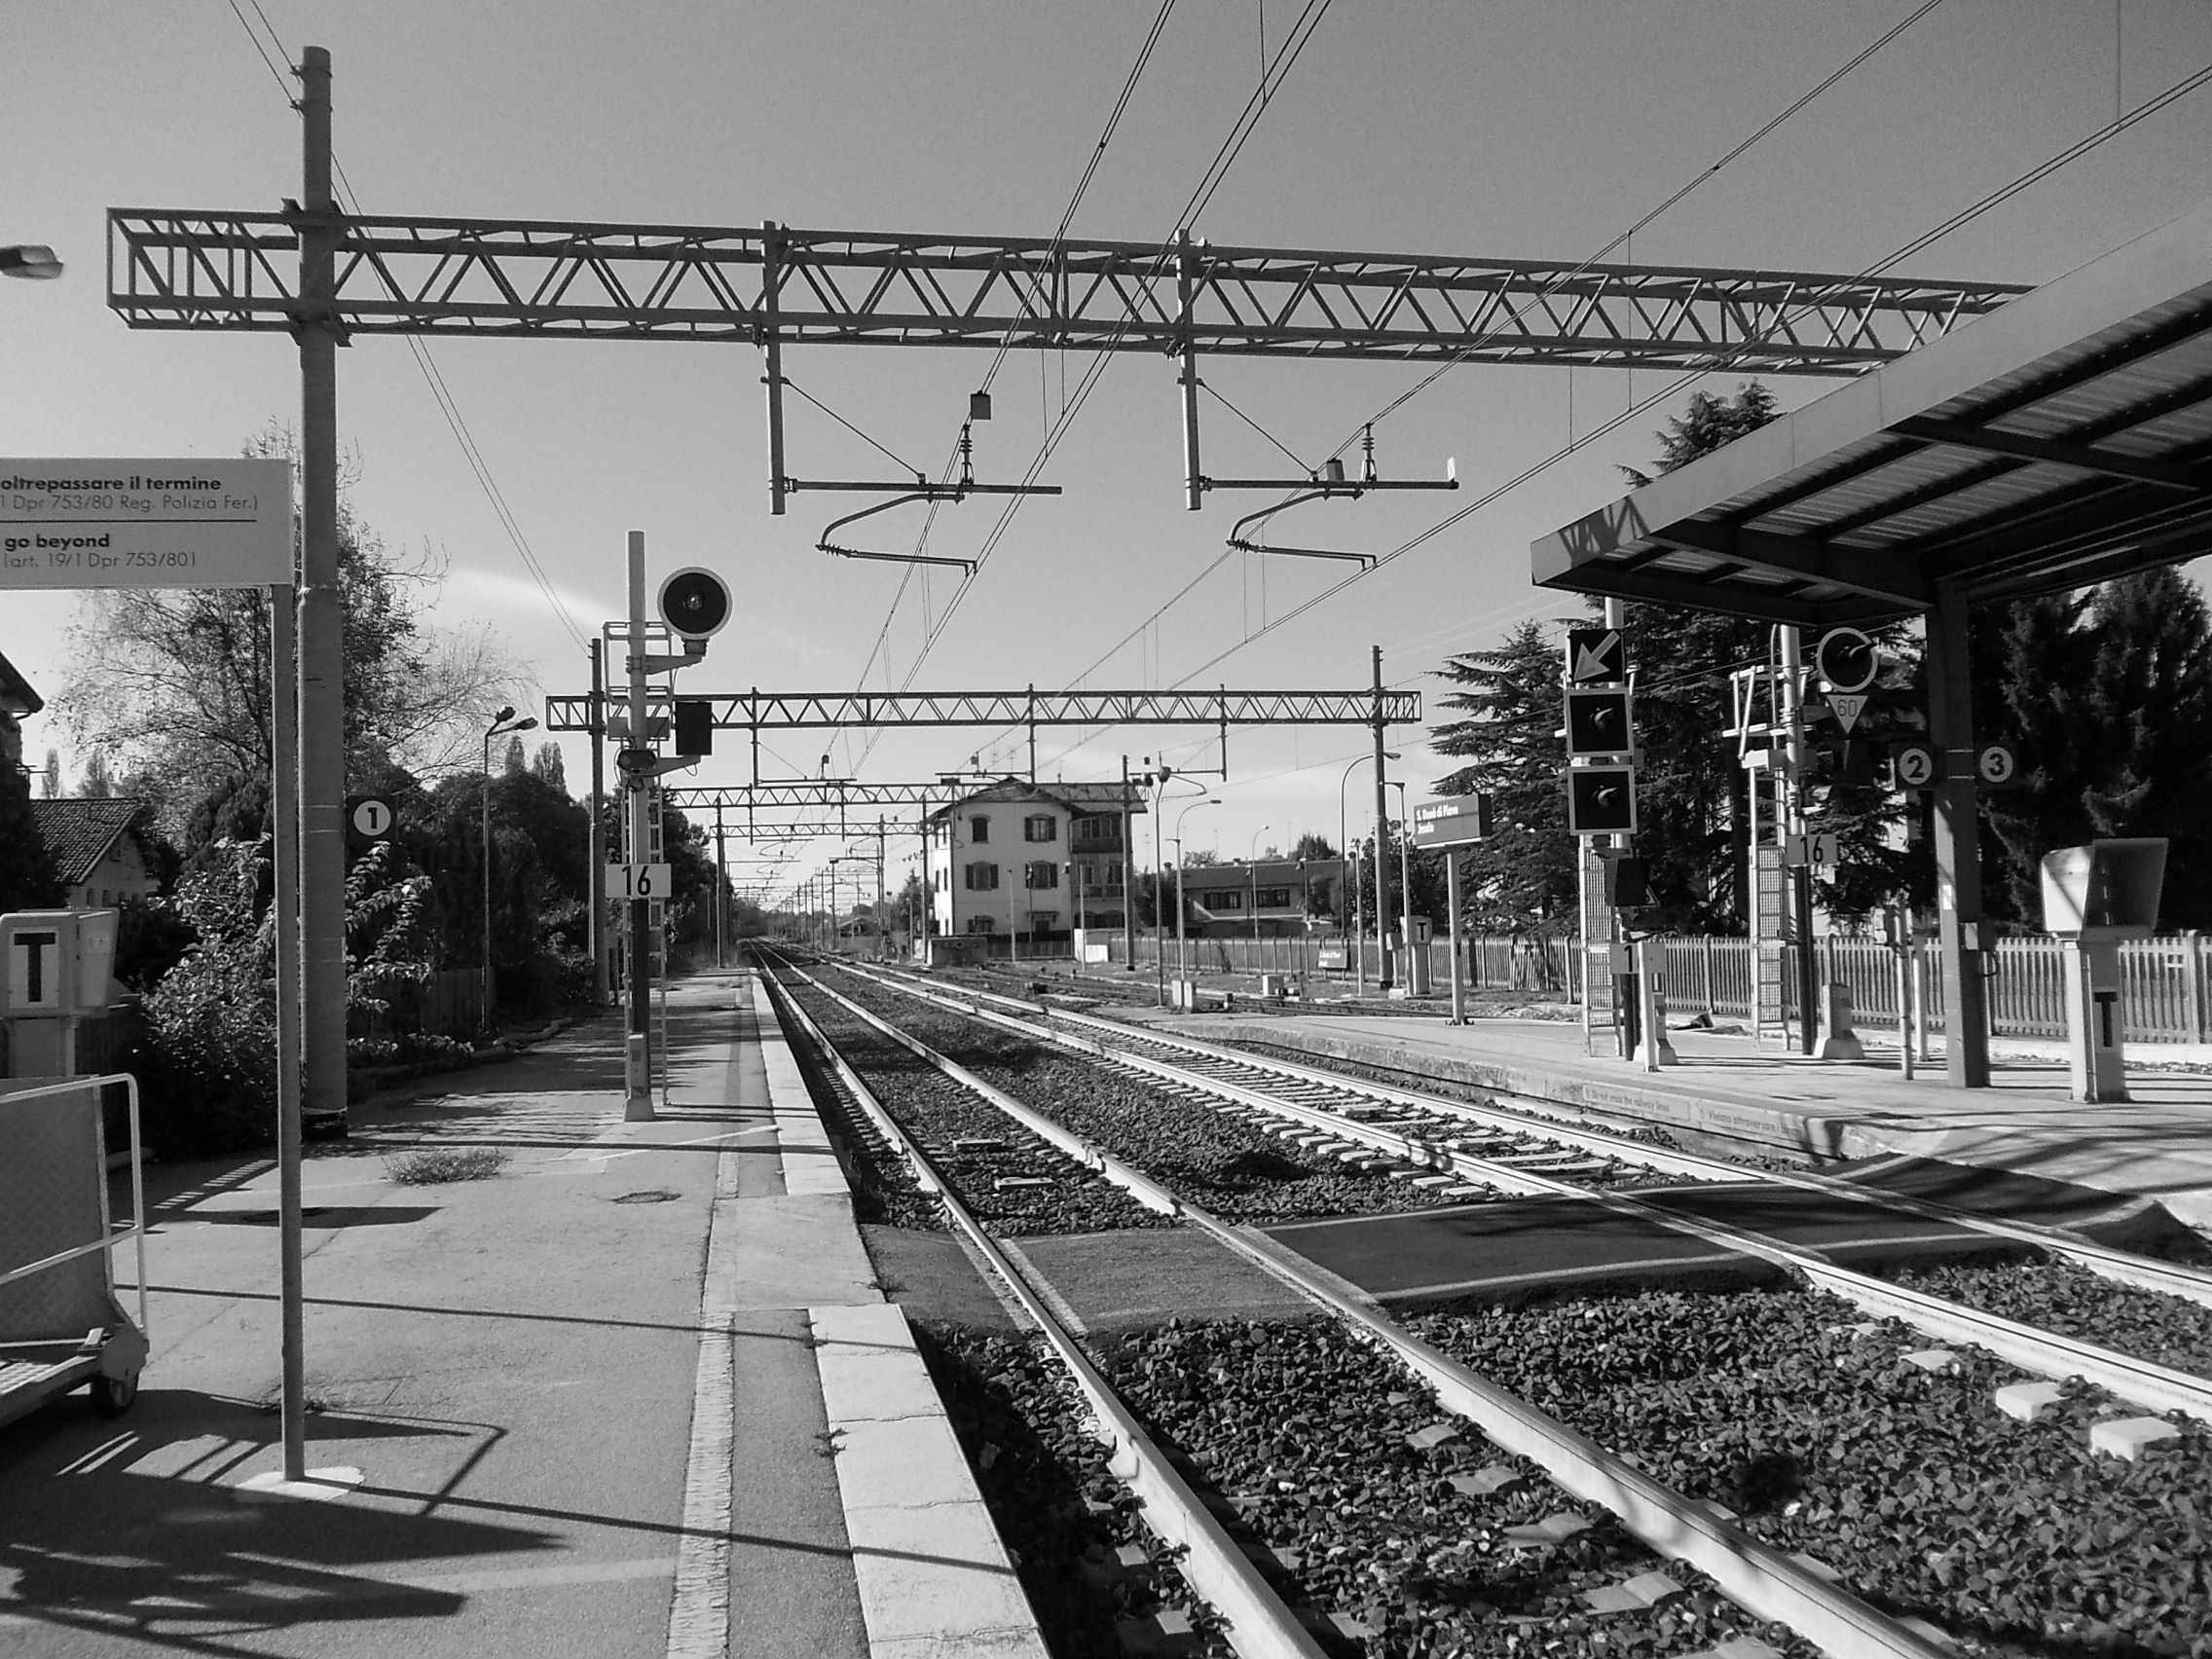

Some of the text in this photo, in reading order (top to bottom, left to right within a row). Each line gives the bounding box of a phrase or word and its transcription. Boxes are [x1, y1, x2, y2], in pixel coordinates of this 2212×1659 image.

[1, 475, 221, 494] oltrepassare il termine
[13, 495, 45, 512] Dpr
[51, 495, 114, 509] 753/80
[120, 495, 156, 513] Reg.
[163, 495, 217, 509] Polizia
[224, 495, 257, 511] Fer.)
[4, 533, 110, 552] go beyond
[4, 551, 195, 570] (art. 19/1 Dpr 753/80)
[1836, 699, 1859, 718] 60
[1906, 755, 1925, 778] 2
[1988, 753, 2006, 776] 3
[367, 807, 378, 830] 1
[1800, 835, 1824, 863] 16
[622, 865, 651, 896] 16
[1417, 922, 1426, 940] T
[14, 932, 55, 1002] T
[2094, 991, 2119, 1038] T
